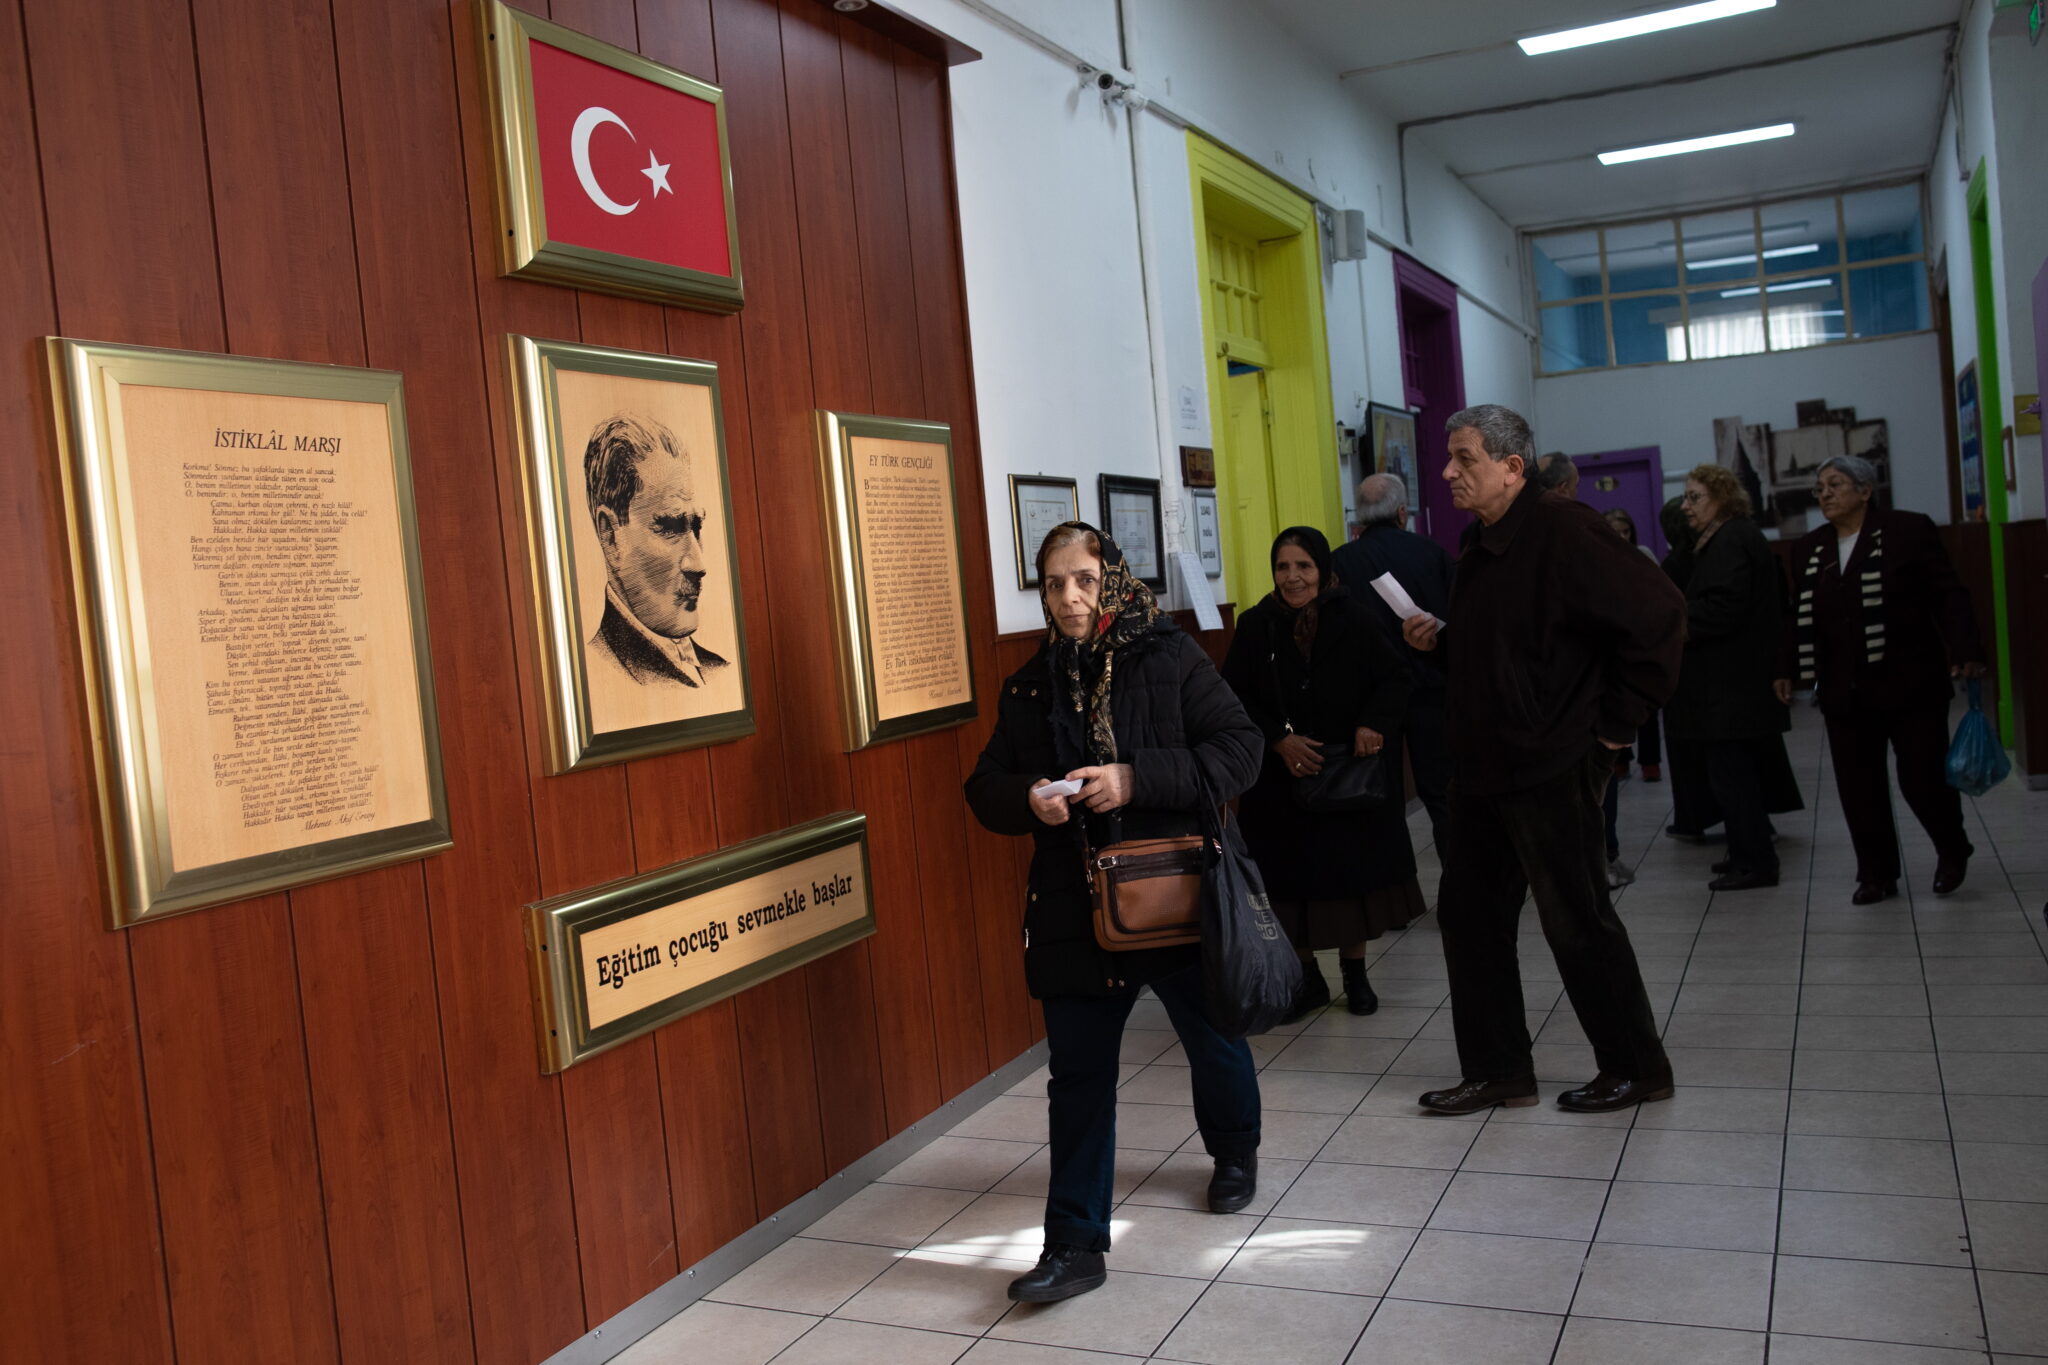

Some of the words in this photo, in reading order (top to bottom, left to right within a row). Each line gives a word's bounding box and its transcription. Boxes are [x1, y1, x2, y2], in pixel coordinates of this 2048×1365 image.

[215, 428, 288, 451] İSTİKLÂL
[294, 435, 342, 457] MARŞI
[596, 943, 661, 989] Eğitim
[669, 921, 729, 968] çocuğu
[737, 889, 806, 934] sevmekle
[811, 874, 852, 907] başlar
